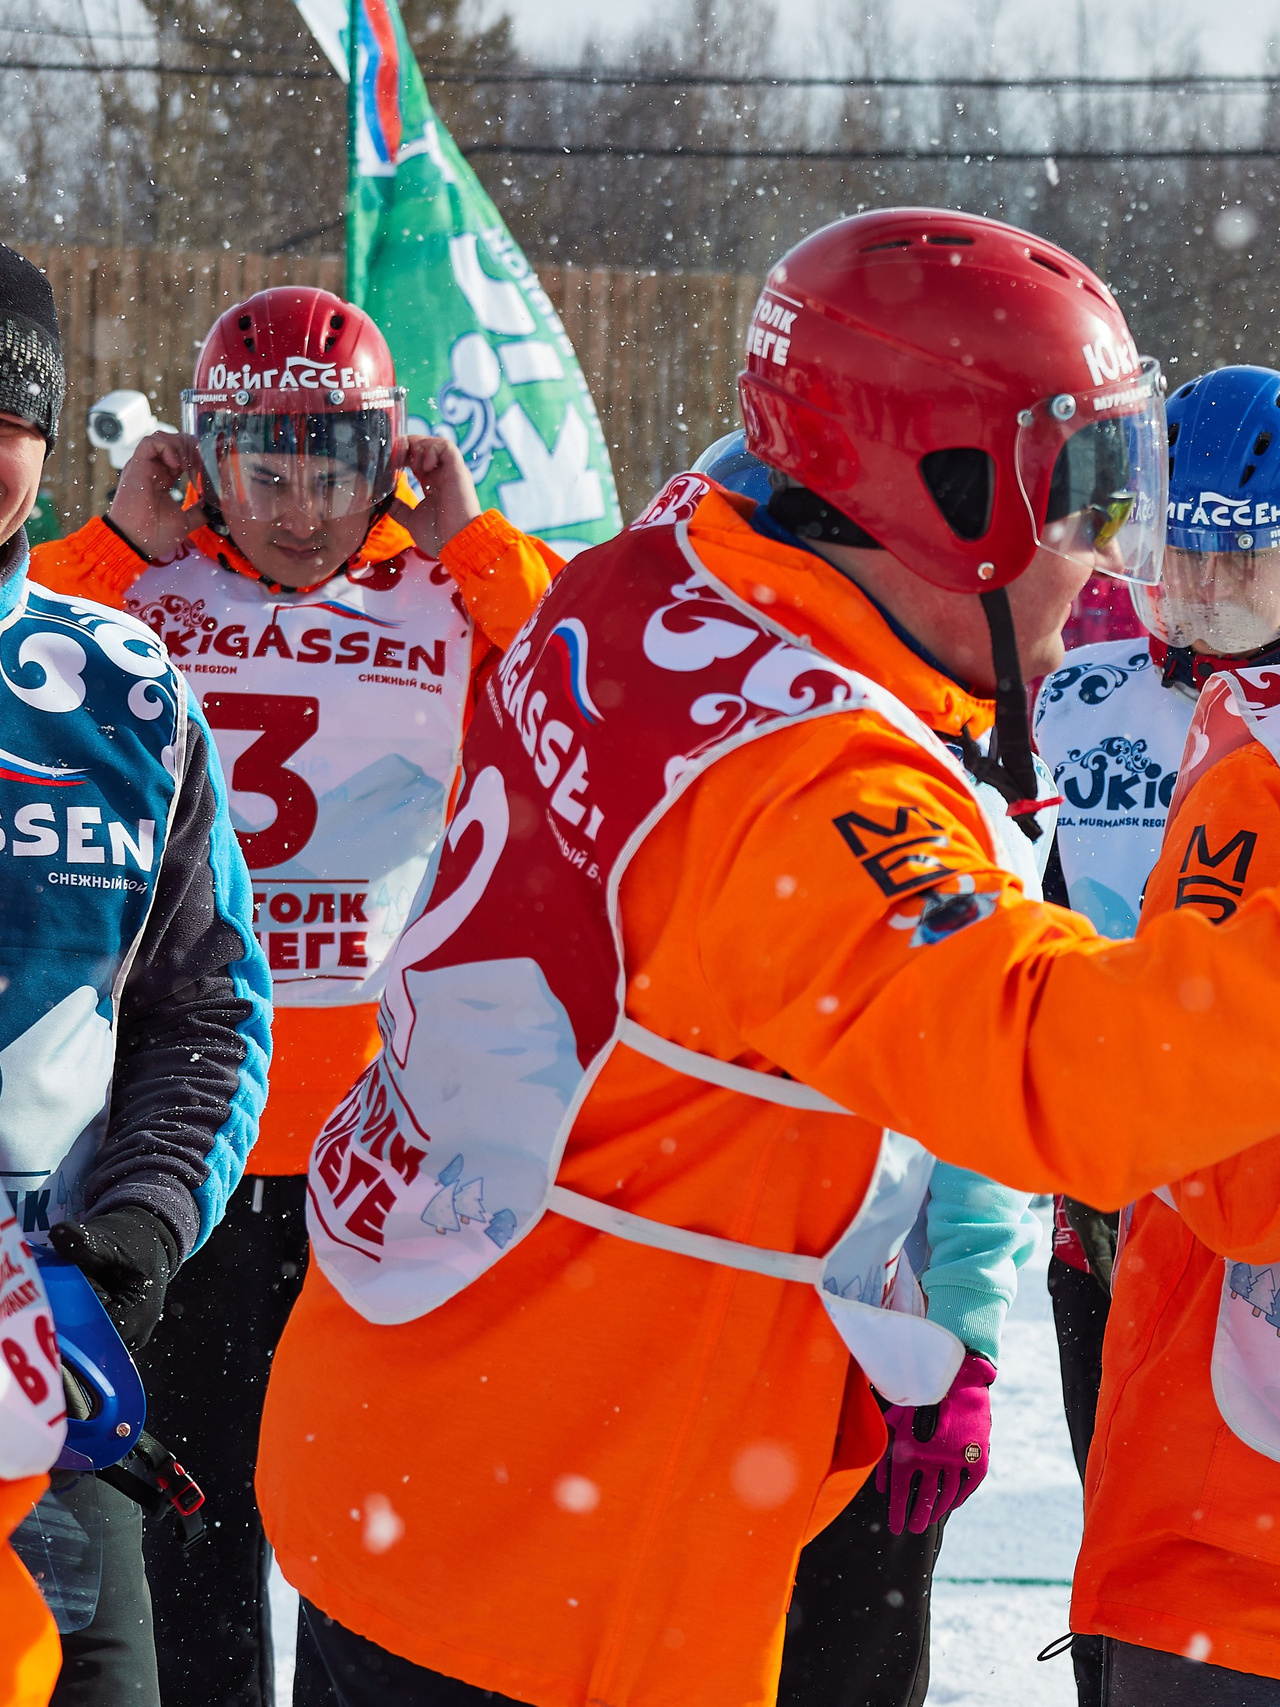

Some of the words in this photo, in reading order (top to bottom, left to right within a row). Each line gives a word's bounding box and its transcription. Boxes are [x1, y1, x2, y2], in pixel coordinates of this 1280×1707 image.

[193, 664, 238, 675] REGION
[358, 673, 417, 688] СНЕЖНЫЙ
[419, 682, 443, 695] БОЙ
[203, 691, 320, 870] 3
[1079, 817, 1139, 828] MURMANSK
[47, 871, 127, 891] СНЕЖНЫЙ
